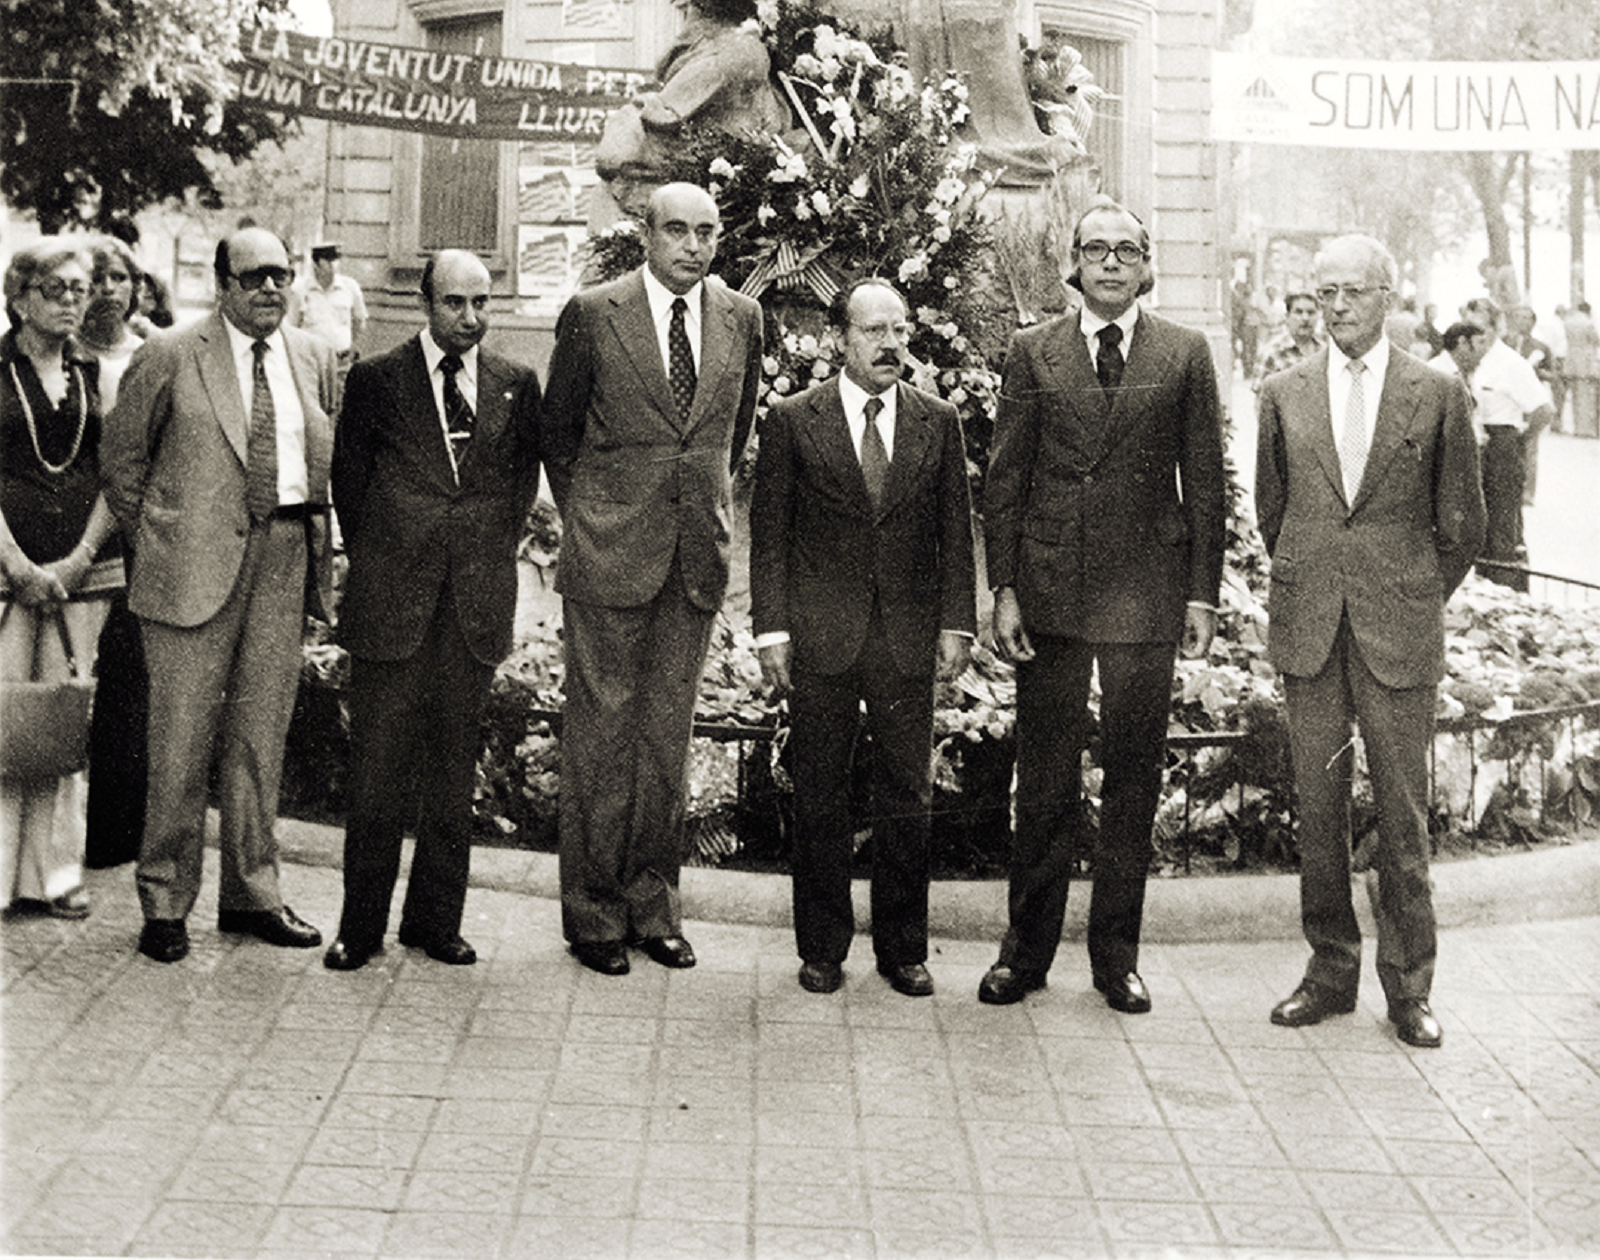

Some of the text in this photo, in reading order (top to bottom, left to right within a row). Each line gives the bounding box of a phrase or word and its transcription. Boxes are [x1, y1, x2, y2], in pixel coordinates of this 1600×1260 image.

[251, 31, 646, 98] LA JOVENTUT UNIDA PER
[242, 70, 619, 134] UNA CATALUNYA LLIUR
[1309, 70, 1413, 130] SOM
[1434, 74, 1530, 132] UNA
